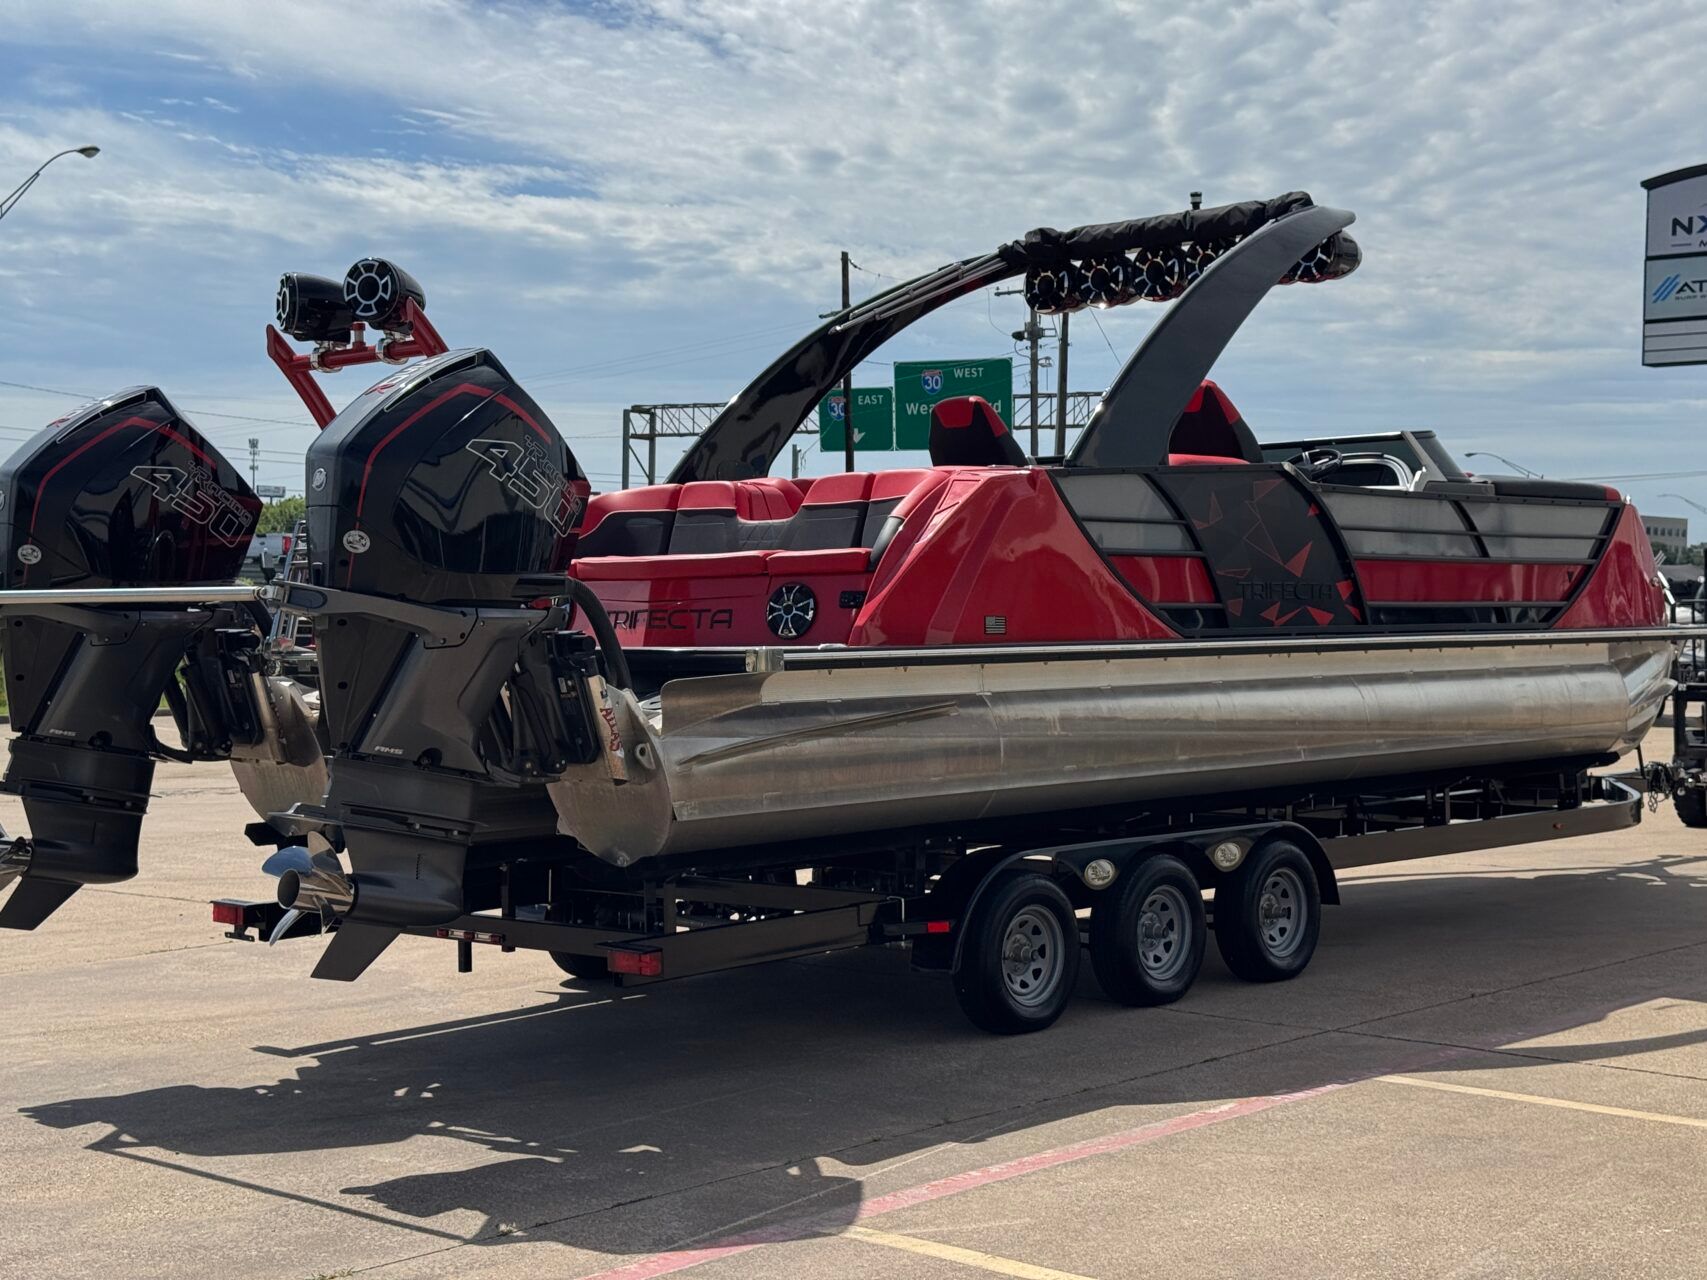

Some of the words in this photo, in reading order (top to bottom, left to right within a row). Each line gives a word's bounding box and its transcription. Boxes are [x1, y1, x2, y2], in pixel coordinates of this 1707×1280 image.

[924, 376, 941, 390] 30
[953, 367, 984, 379] WEST
[858, 394, 884, 406] EAST
[465, 439, 578, 538] 450
[130, 466, 248, 548] 450
[1238, 581, 1333, 600] TRIFECTA
